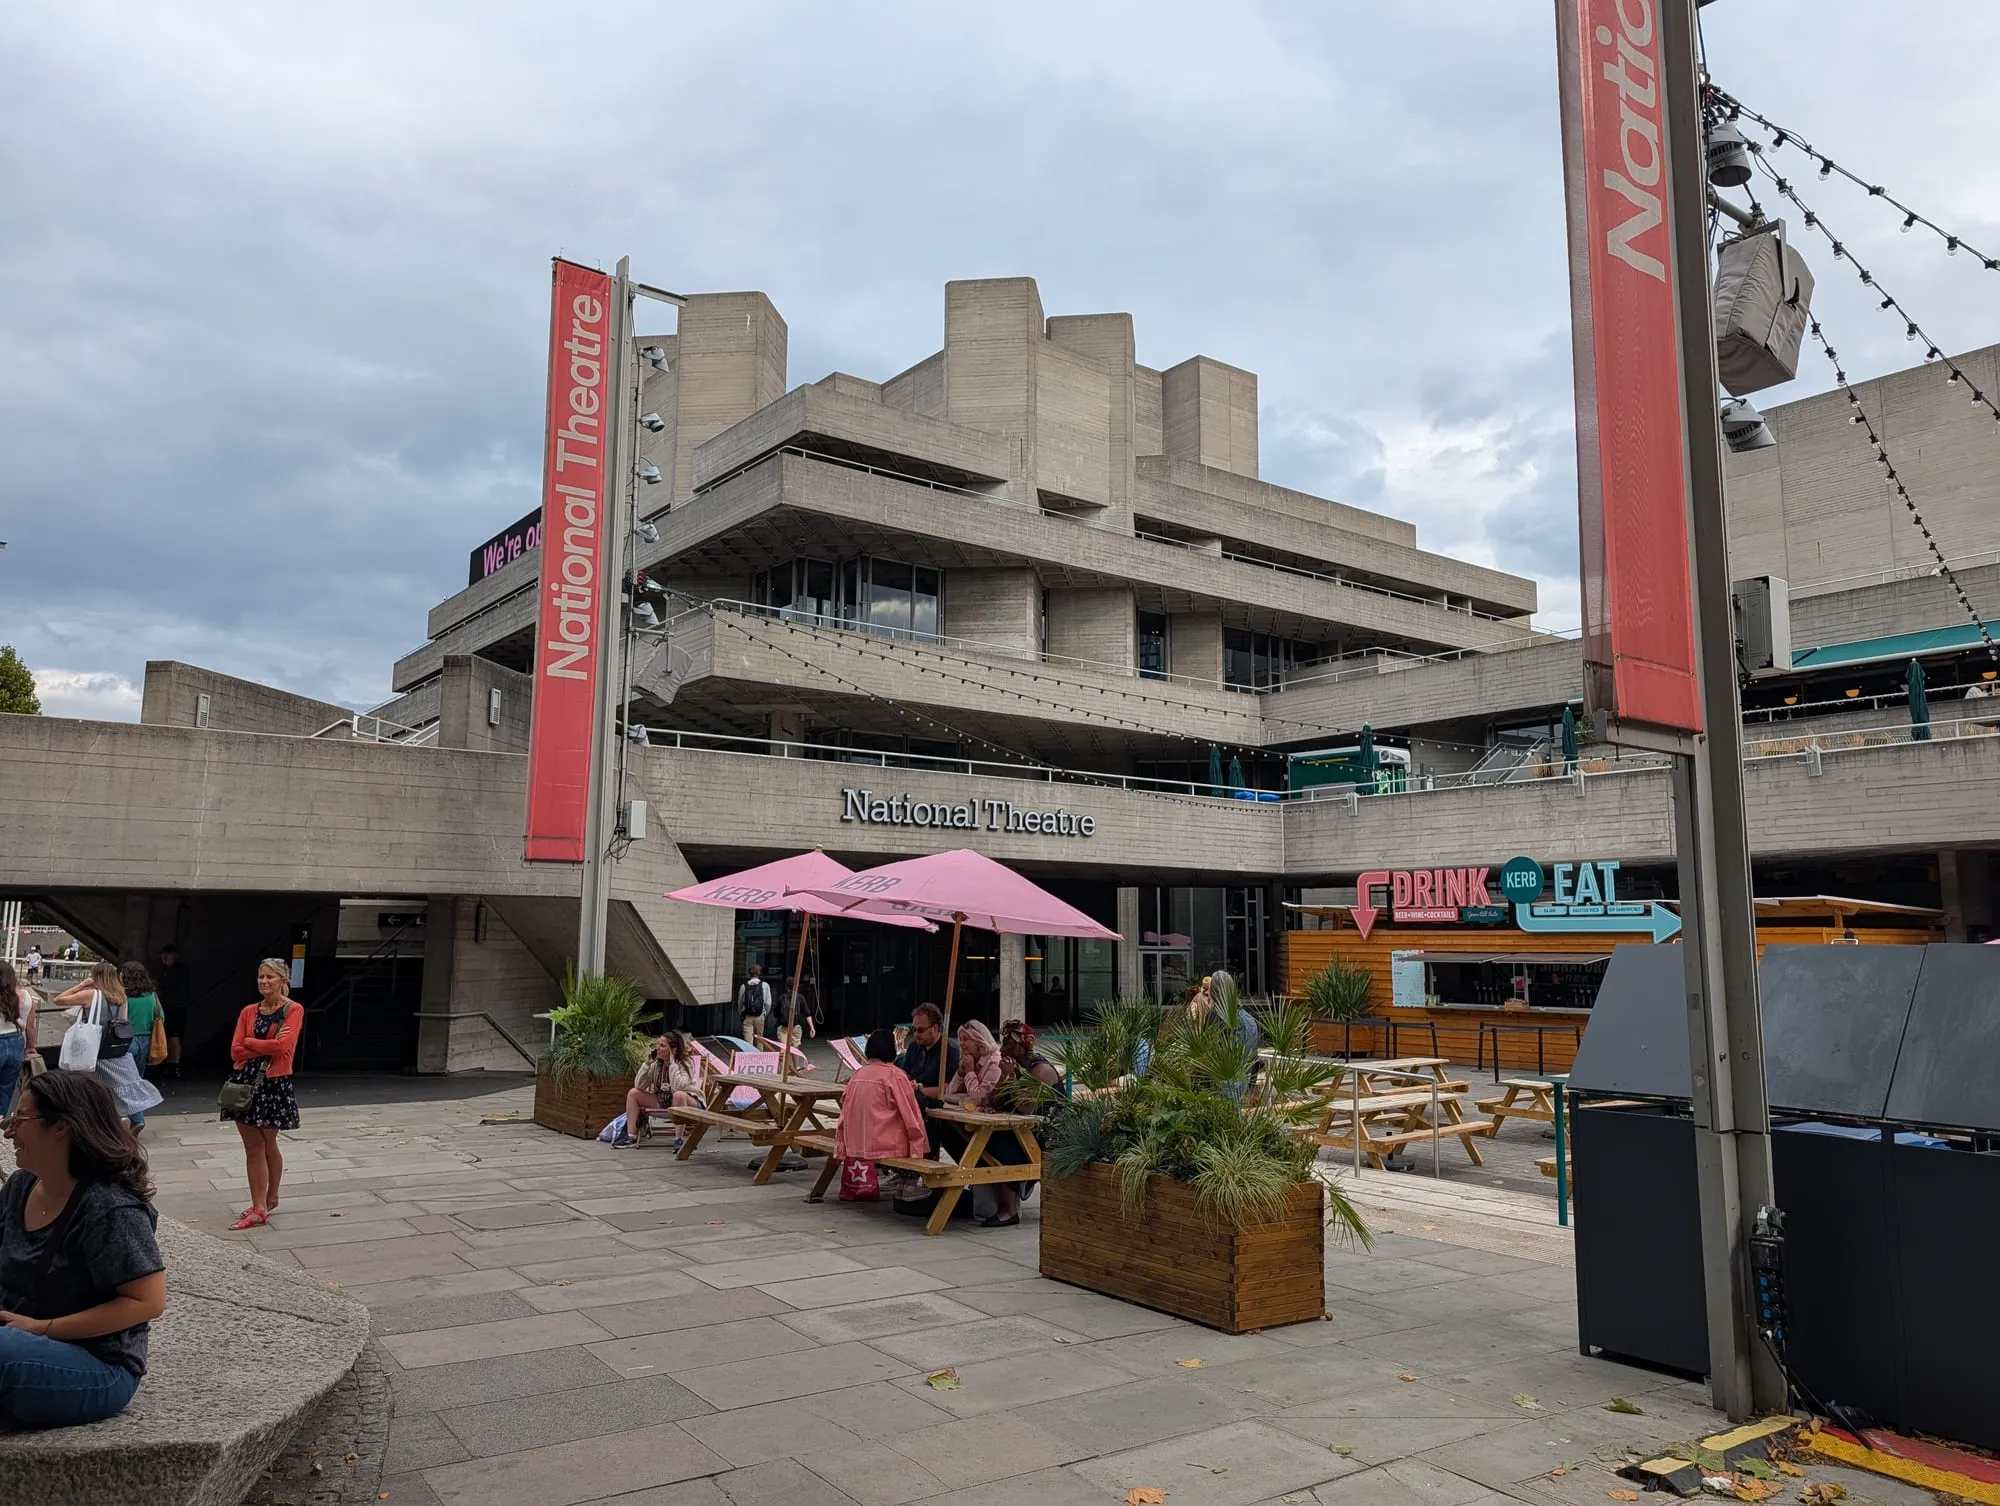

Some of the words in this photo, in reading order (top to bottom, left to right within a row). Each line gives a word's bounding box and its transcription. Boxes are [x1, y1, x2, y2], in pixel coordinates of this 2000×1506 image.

[556, 294, 604, 472] Theatre
[483, 534, 522, 577] We're
[546, 482, 596, 681] National
[841, 787, 981, 829] National
[984, 799, 1096, 836] Theatre
[704, 884, 777, 905] KERB
[833, 873, 902, 894] KERB
[1392, 867, 1491, 909] DRINK
[1506, 871, 1537, 889] KERB
[1554, 860, 1620, 903] EAT
